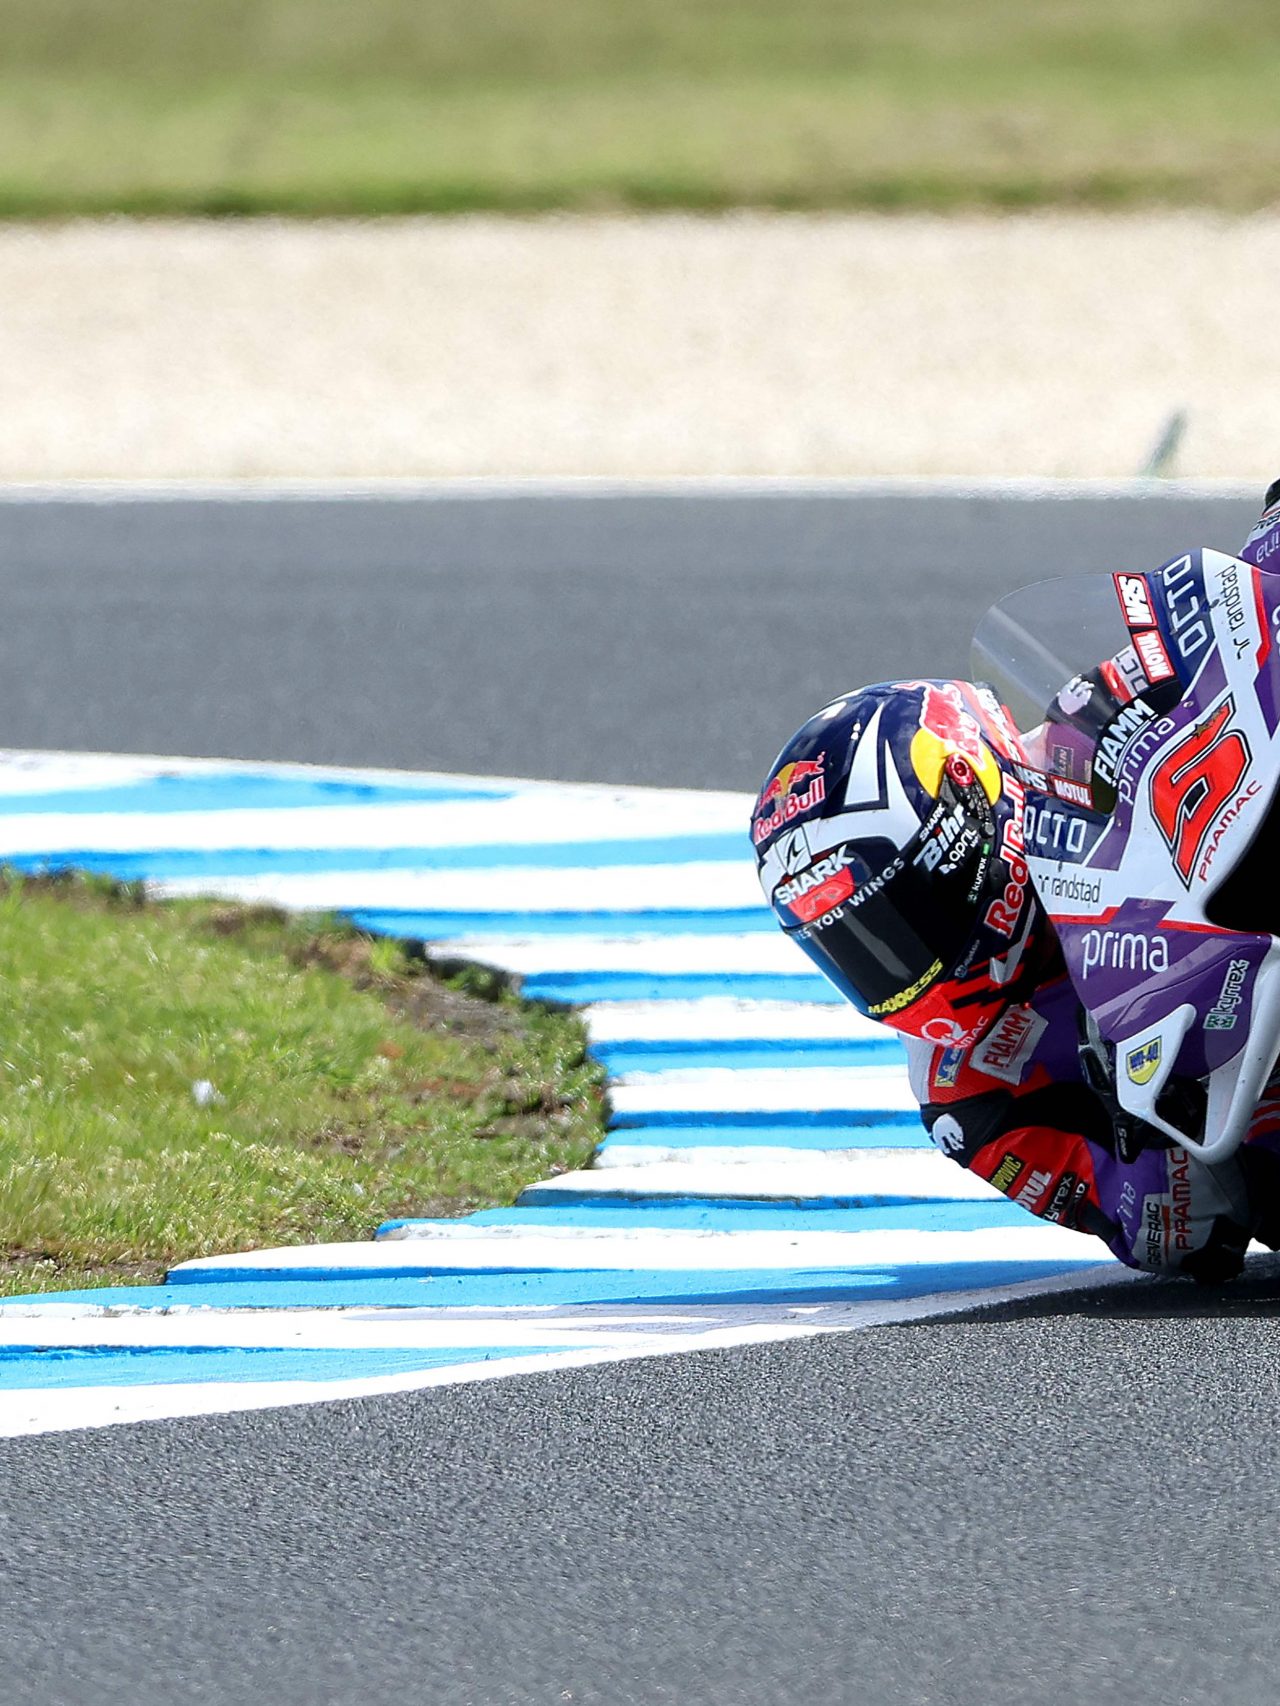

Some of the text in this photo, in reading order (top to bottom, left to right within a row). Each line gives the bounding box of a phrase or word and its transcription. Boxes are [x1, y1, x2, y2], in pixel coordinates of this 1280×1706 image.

[1162, 554, 1208, 658] OCTO
[1214, 564, 1245, 633] randstad
[1136, 632, 1170, 678] MOTUL
[1094, 699, 1155, 785] FIAMM
[1119, 718, 1176, 805] prima
[754, 775, 826, 846] Red Bull
[1054, 779, 1091, 806] MOTUL
[912, 802, 965, 872] Bihr
[949, 828, 977, 861] april
[1024, 805, 1087, 853] OCTO
[1199, 780, 1262, 881] PRAMAC
[775, 844, 855, 905] SHARK
[813, 857, 905, 930] YOU WINGS
[984, 845, 1028, 940] Red
[1050, 873, 1101, 905] randstad
[1081, 928, 1169, 980] prima
[1218, 959, 1250, 1015] kyrrex
[983, 1012, 1031, 1069] FIAMM
[1171, 1149, 1194, 1250] PRAMAC
